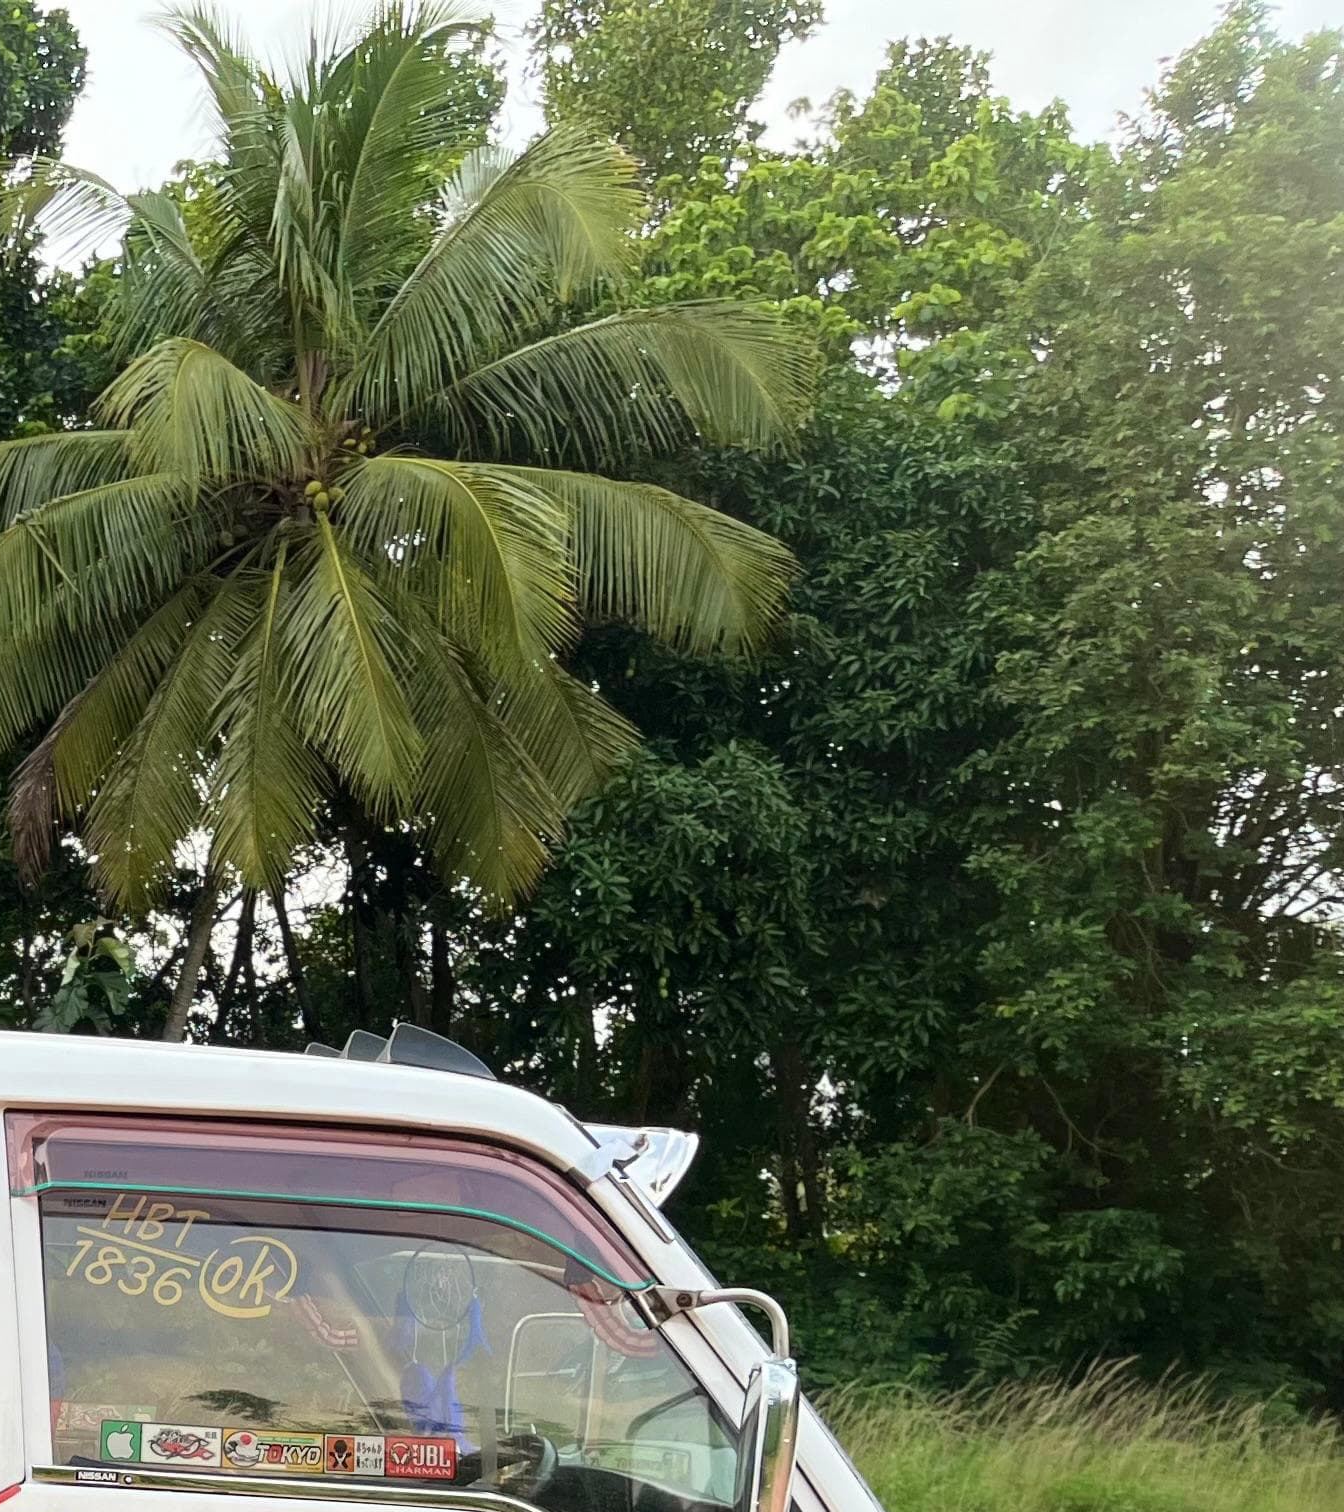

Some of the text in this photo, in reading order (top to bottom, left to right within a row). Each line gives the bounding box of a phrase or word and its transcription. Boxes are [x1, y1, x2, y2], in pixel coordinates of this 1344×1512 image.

[102, 1193, 210, 1248] HBT
[66, 1240, 192, 1305] 1836
[255, 1442, 322, 1466] TOKYO
[412, 1444, 451, 1468] JBL
[77, 1471, 117, 1482] NISSAN
